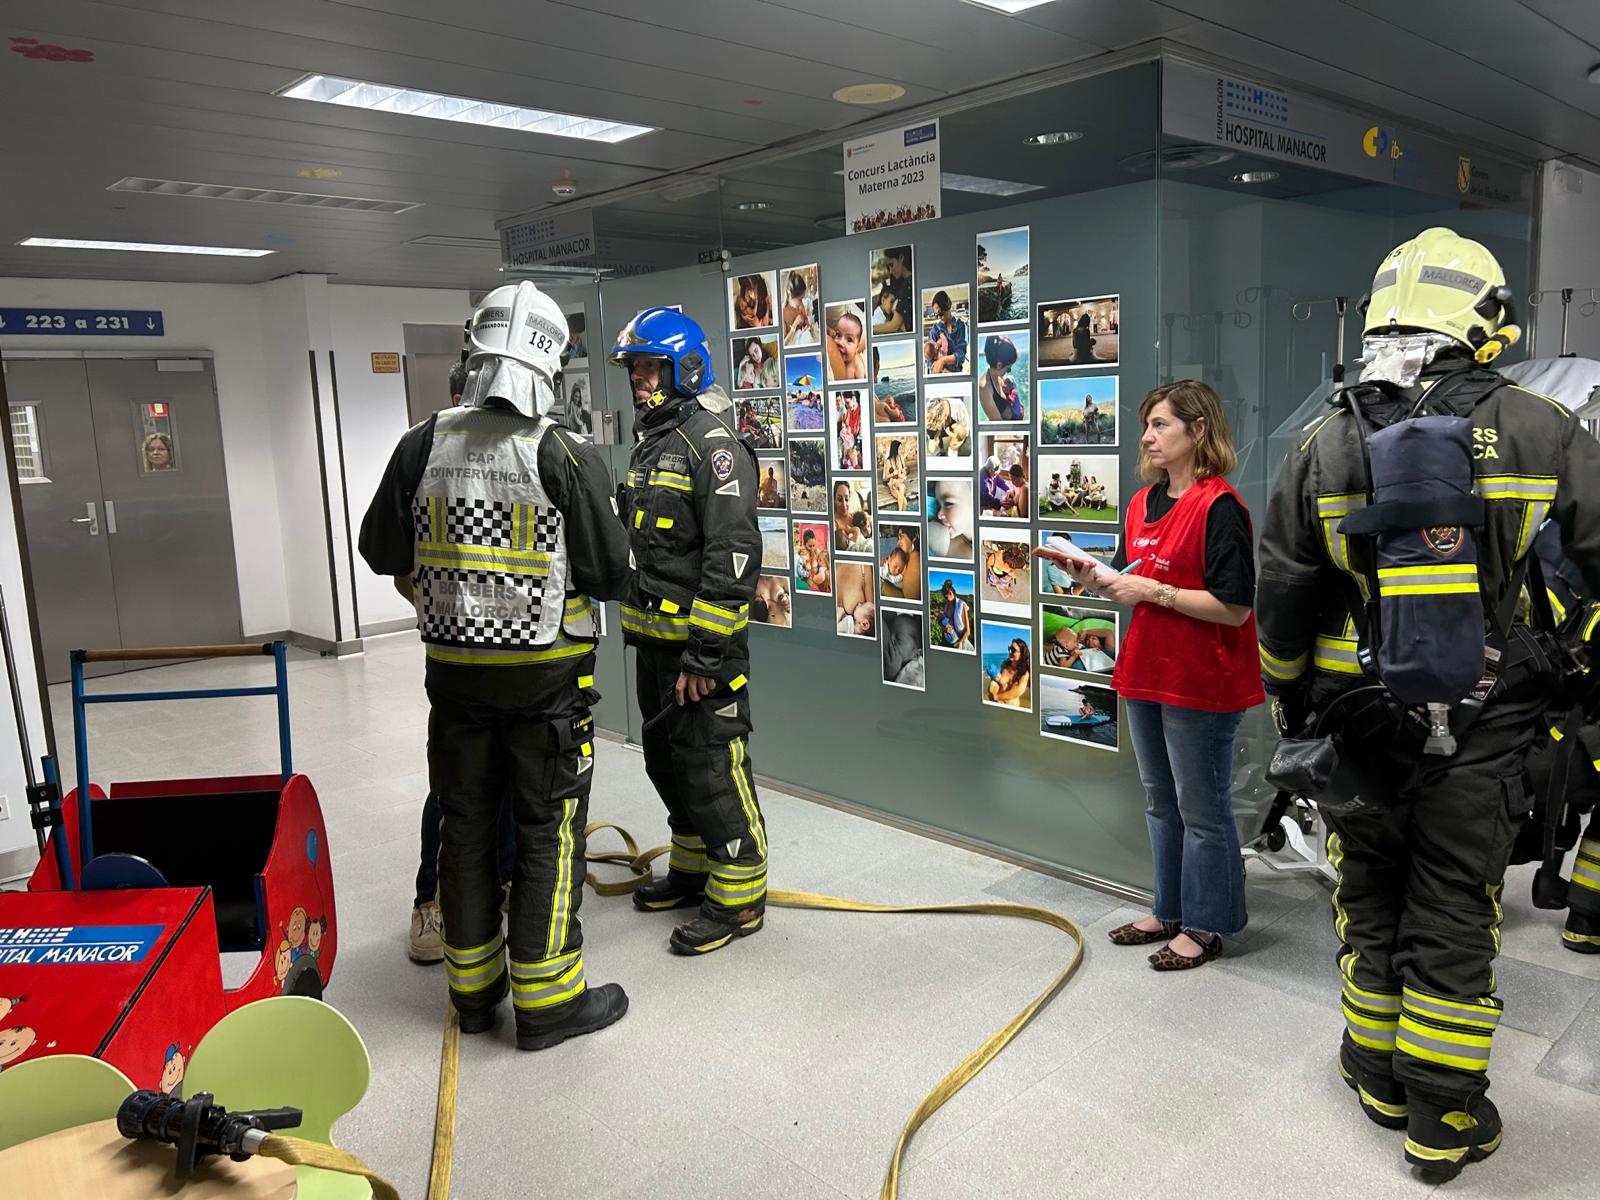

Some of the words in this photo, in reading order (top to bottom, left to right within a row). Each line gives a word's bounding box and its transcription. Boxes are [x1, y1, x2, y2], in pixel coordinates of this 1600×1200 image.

[1225, 122, 1275, 151] HOSPITAL
[1277, 134, 1327, 162] MANACOR
[847, 163, 886, 182] Concurs
[887, 151, 936, 173] Lactància
[858, 176, 899, 195] Materna
[901, 170, 925, 186] 2023
[512, 248, 547, 267] HOSPITAL
[548, 238, 591, 259] MANACOR
[1423, 269, 1481, 291] MALLORCA
[25, 315, 66, 329] 223
[74, 318, 87, 329] a
[95, 316, 129, 329] 231
[528, 331, 553, 354] 182
[466, 451, 496, 464] CAP
[438, 581, 517, 600] BOMBERS
[435, 600, 522, 620] MALLORCA
[36, 945, 139, 963] MANACOR
